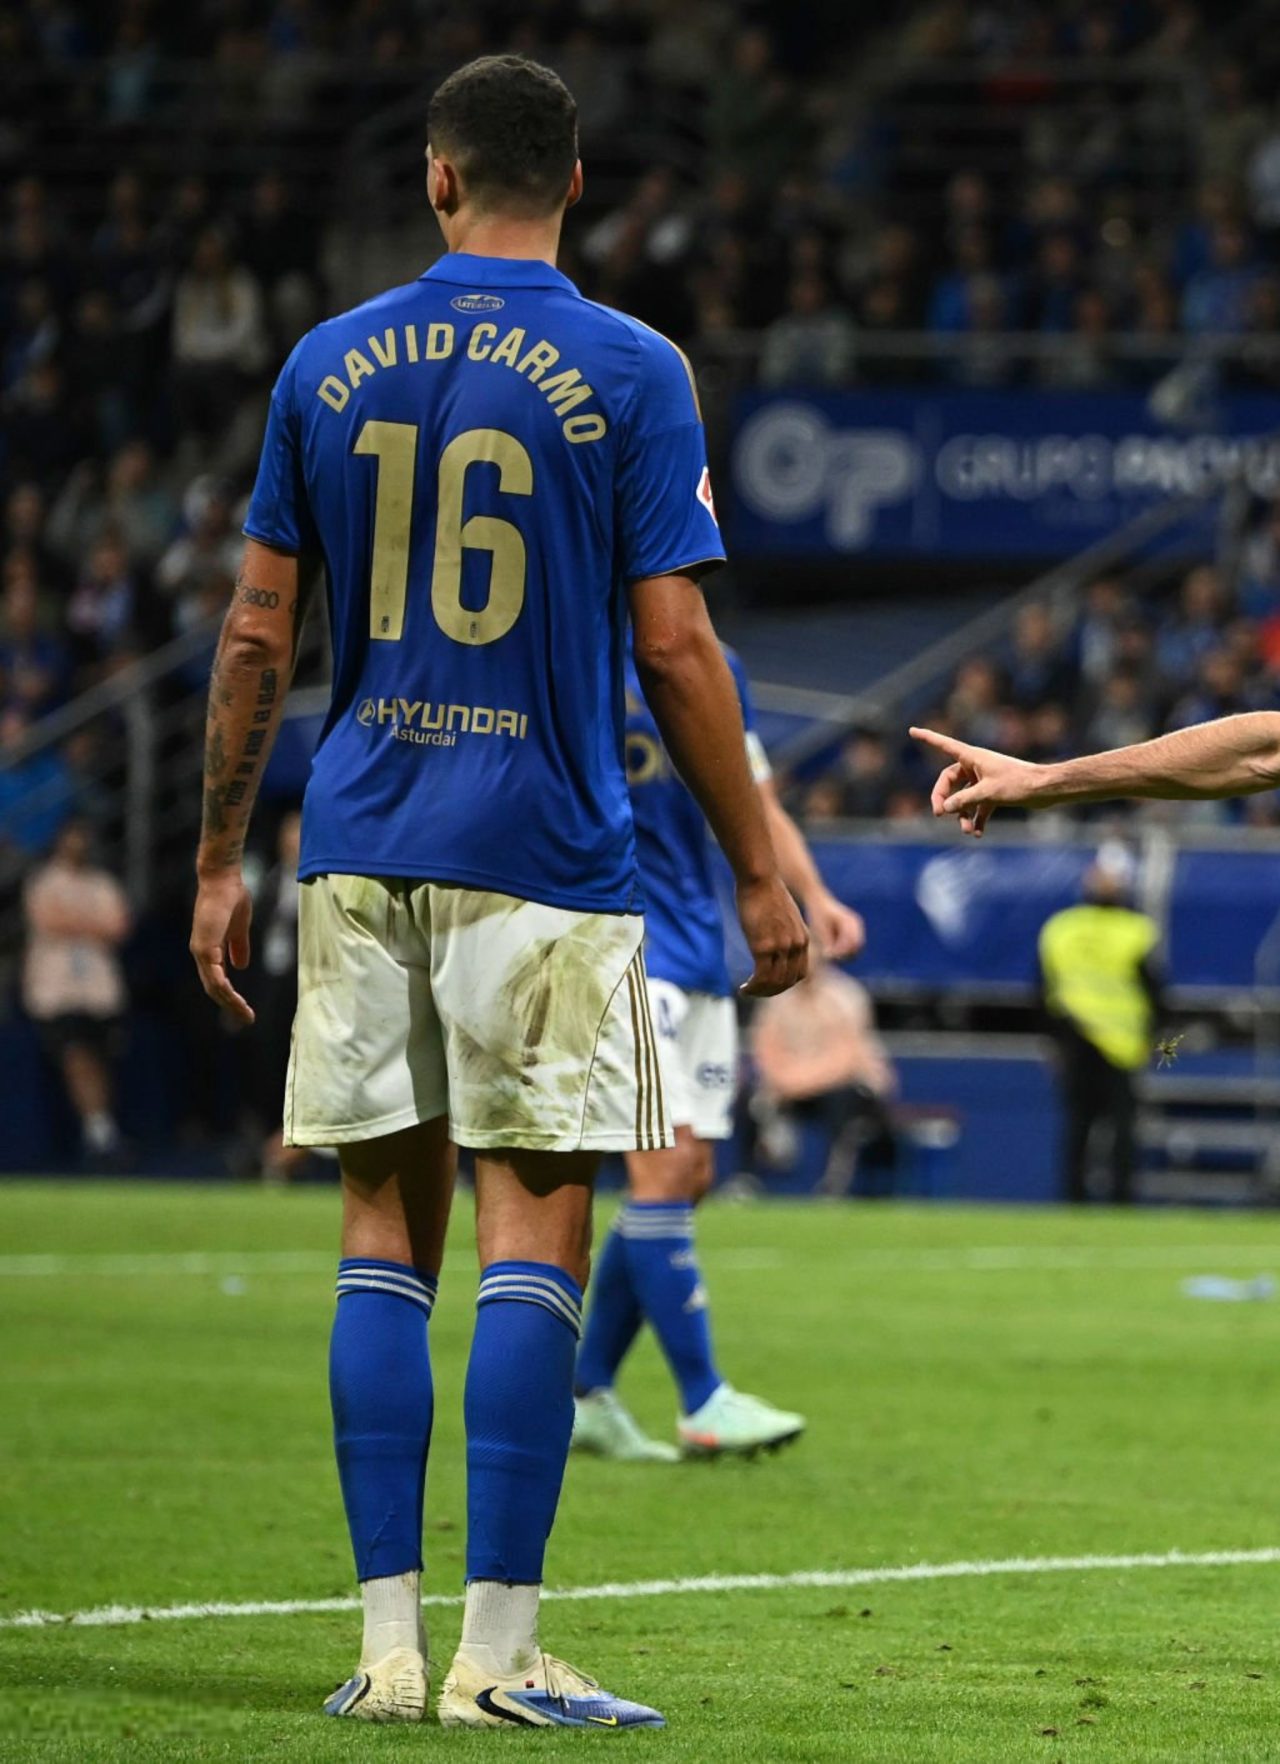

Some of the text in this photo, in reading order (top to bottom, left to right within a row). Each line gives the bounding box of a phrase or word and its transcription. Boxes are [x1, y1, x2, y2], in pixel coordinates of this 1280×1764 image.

[316, 322, 606, 444] DAVID CARMO
[352, 419, 534, 646] 16
[377, 698, 528, 740] HYUNDAI
[389, 724, 457, 747] Asturdai
